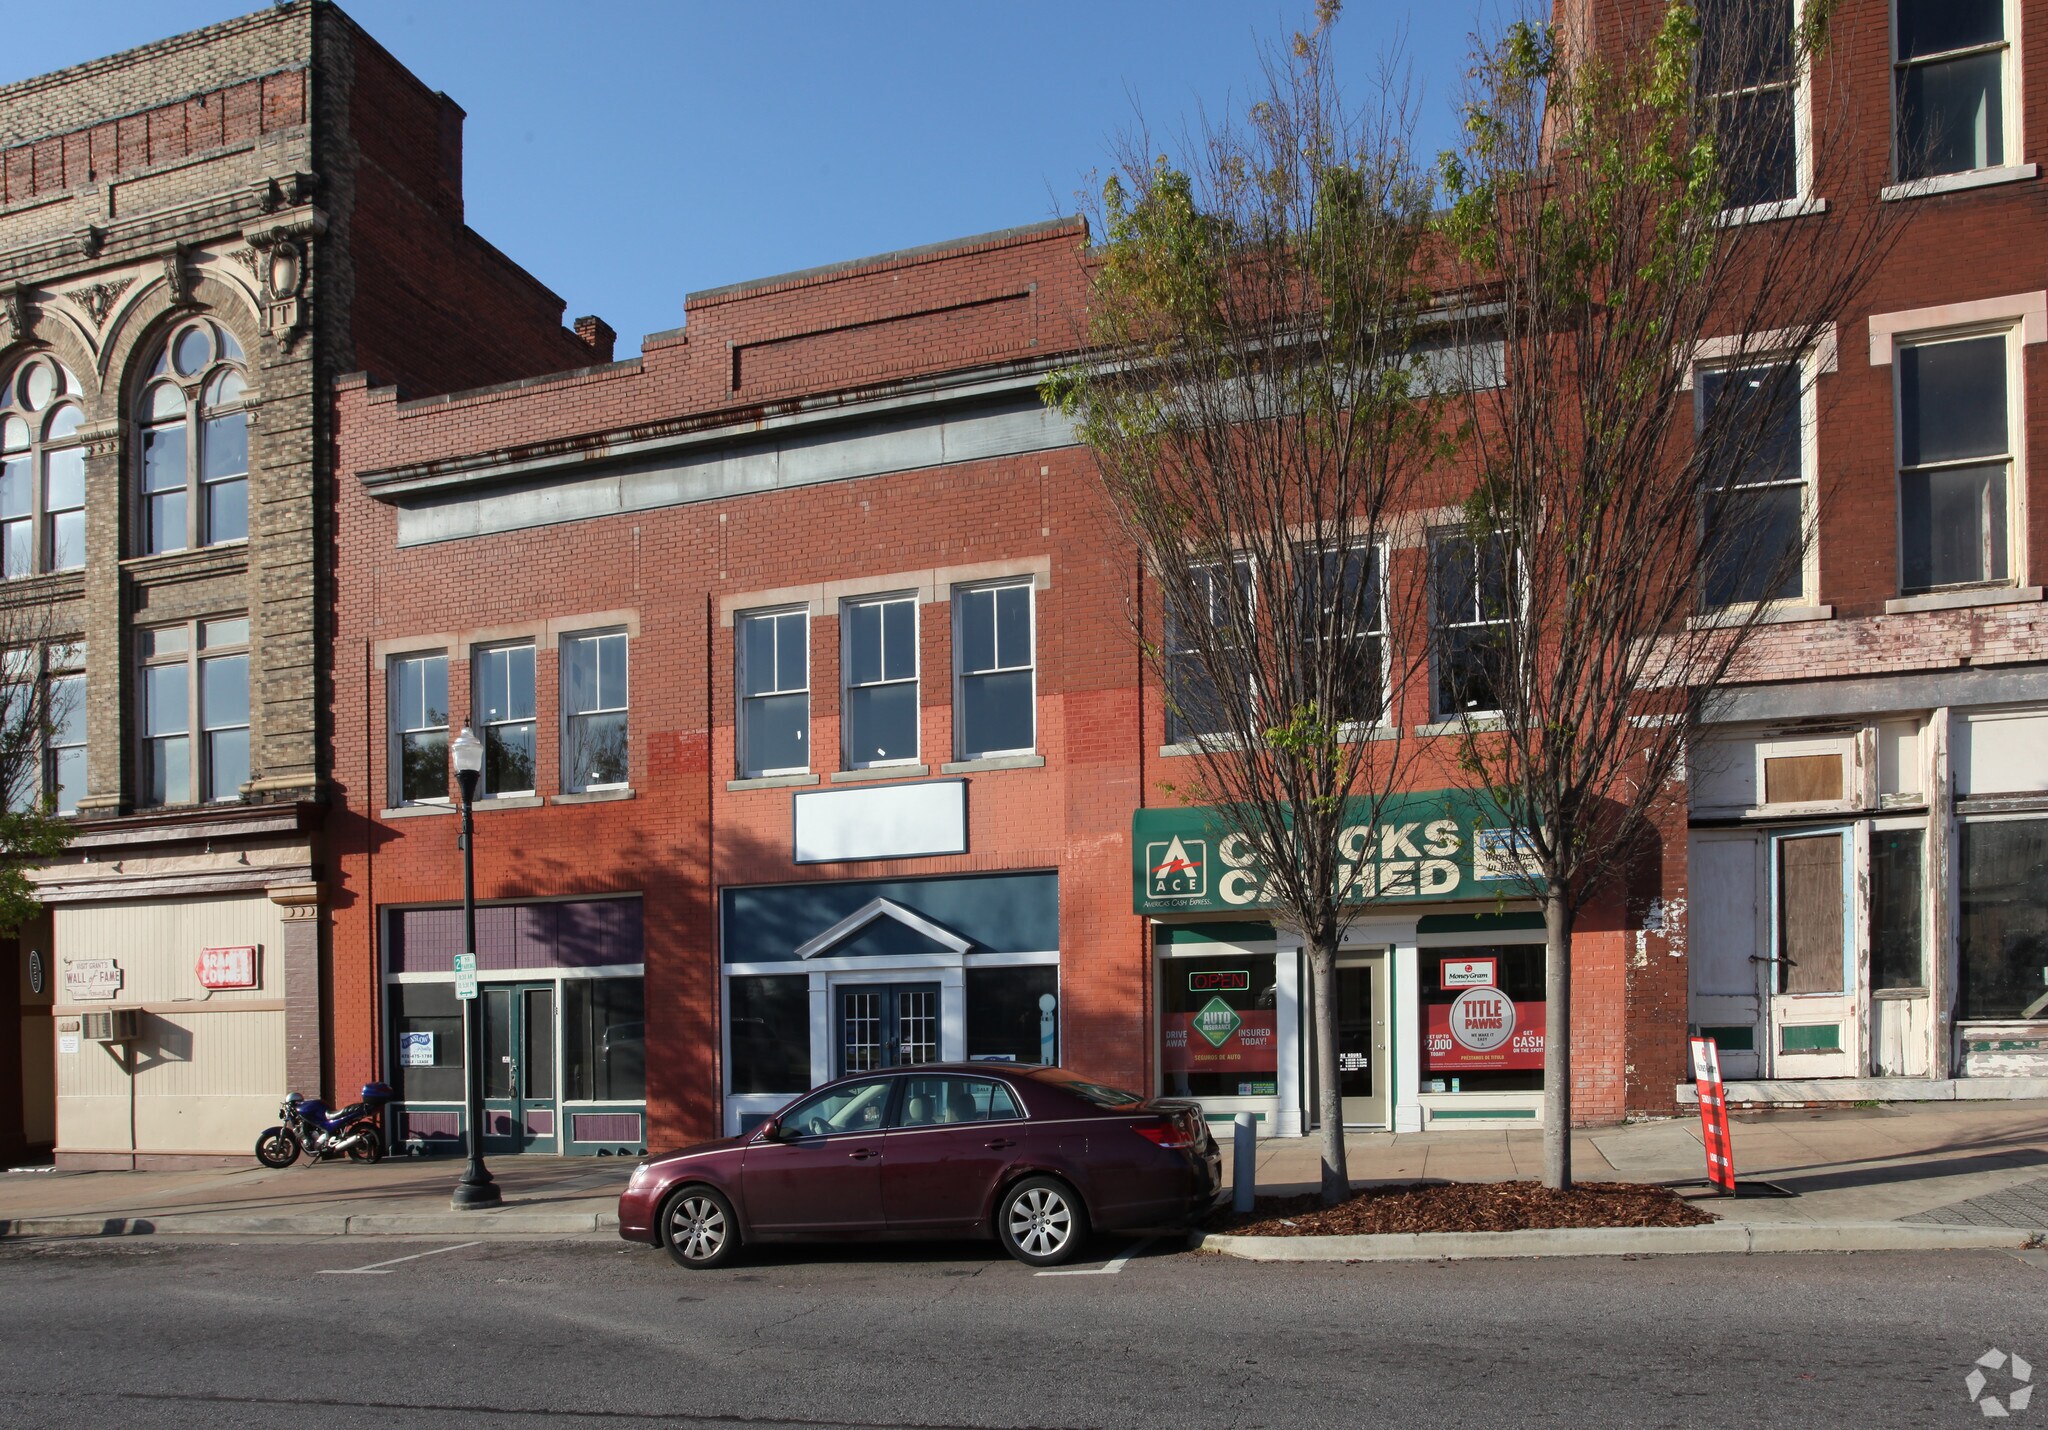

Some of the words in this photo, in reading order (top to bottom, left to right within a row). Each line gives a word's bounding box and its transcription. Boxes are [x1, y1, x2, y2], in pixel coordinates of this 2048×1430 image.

[1219, 819, 1462, 868] CCKS
[1155, 879, 1197, 892] ACE
[1219, 859, 1460, 905] CAHED
[1171, 898, 1188, 907] CASH
[456, 958, 461, 970] 2
[66, 972, 86, 984] WALL
[88, 969, 98, 989] of
[99, 970, 120, 982] FAME
[1194, 973, 1245, 988] OPEN
[1463, 1000, 1501, 1018] TITLE
[1203, 1011, 1231, 1024] AUTO
[1465, 1018, 1502, 1029] PAWNS
[1203, 1023, 1231, 1031] INSURANCE
[1238, 1029, 1271, 1037] INSURED
[1166, 1031, 1188, 1039] DRIVE
[1166, 1039, 1188, 1047] AWAY
[1240, 1038, 1267, 1046] TODAY!
[1513, 1036, 1544, 1048] CASH
